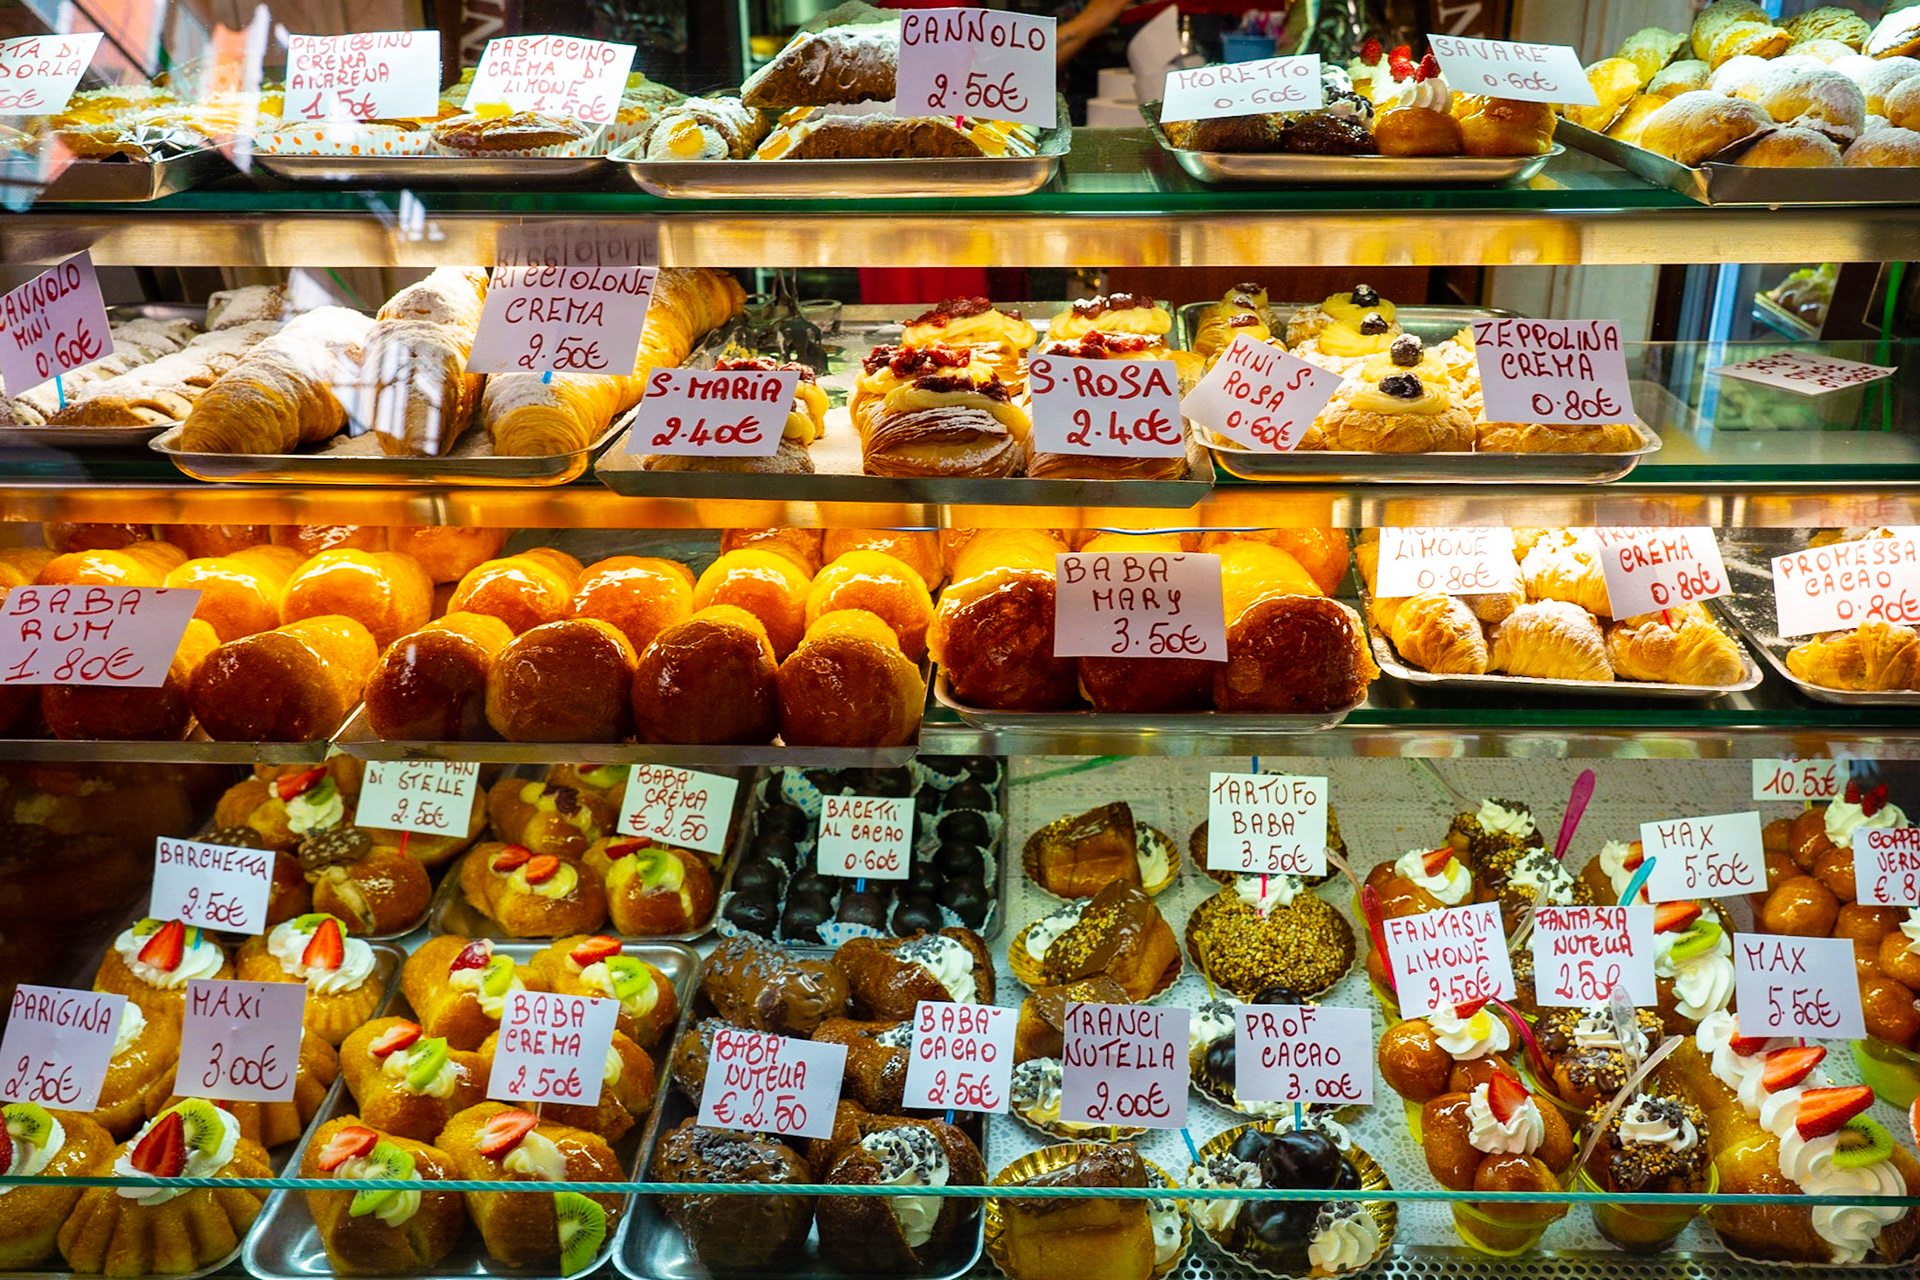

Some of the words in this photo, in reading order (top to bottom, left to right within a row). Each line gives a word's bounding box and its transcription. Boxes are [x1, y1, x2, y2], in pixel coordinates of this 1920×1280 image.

[289, 31, 413, 55] PASTICCINO
[902, 10, 1045, 51] CANNOLO
[297, 51, 367, 71] CREMA
[490, 36, 616, 64] PASTICCINO
[292, 62, 389, 90] AMARENA
[488, 58, 555, 77] CREMA
[1179, 59, 1309, 89] MORETTO
[1483, 71, 1558, 92] 0.60€
[503, 79, 586, 98] LIMONE
[927, 72, 1029, 113] 2.50€
[1214, 85, 1307, 109] 0.60€
[531, 95, 611, 122] 1.50€
[492, 265, 654, 296] RICCIOLONE
[505, 297, 604, 327] CREMA
[36, 317, 103, 379] 0.60€
[518, 333, 609, 370] 2.50€
[1475, 319, 1619, 352] ZEPPOLINA
[1073, 364, 1173, 400] ROSA
[1501, 351, 1595, 382] CREMA
[1223, 370, 1285, 413] ROSA
[1532, 387, 1623, 421] 0.80€
[651, 415, 764, 447] 2.40€
[1067, 408, 1183, 448] 2.40€
[1226, 410, 1294, 452] 0.60€
[1395, 537, 1488, 561] LIMONE
[1619, 534, 1694, 573] CREMA
[1779, 539, 1917, 580] PROMESSA
[1417, 562, 1500, 591] 0.80€
[1651, 562, 1721, 605] 0.80€
[1805, 568, 1892, 597] CACAO
[1092, 587, 1182, 616] MARY
[20, 618, 115, 642] RUM
[1111, 617, 1207, 655] 3.50€
[5, 647, 145, 681] 1.80€
[398, 770, 465, 797] STELLE
[1212, 775, 1317, 806] TARTUFO
[1762, 764, 1841, 798] 10.50€
[391, 797, 450, 829] 2.50€
[645, 788, 708, 812] CREMA
[826, 798, 901, 822] BACETTI
[820, 822, 841, 839] AL
[850, 824, 904, 843] CACAO
[1657, 821, 1714, 851] MAX
[1868, 828, 1920, 851] COPPA
[160, 842, 268, 881] BARCHETTA
[844, 848, 900, 872] 0.60€
[1241, 840, 1313, 874] 3.50€
[1685, 852, 1755, 889] 5.50€
[181, 886, 249, 927] 2.50€
[1535, 906, 1628, 931] FANTASIA
[1389, 910, 1497, 945] FANTASIA
[1406, 936, 1490, 975] LIMONE
[1553, 932, 1634, 958] NUTELLA
[1744, 941, 1807, 975] MAX
[1768, 985, 1842, 1028] 5.50€
[505, 1028, 581, 1058] CREMA
[920, 1035, 997, 1063] CACAO
[1064, 1038, 1175, 1070] NUTELLA
[1261, 1042, 1342, 1068] CACAO
[4, 1055, 82, 1105] 2.50€
[202, 1042, 289, 1091] 3.00€
[508, 1064, 583, 1098] 2.50€
[723, 1060, 807, 1092] NUTELLA
[927, 1069, 1000, 1110] 2.50€
[1086, 1081, 1171, 1121] 2.00€
[1286, 1073, 1363, 1101] 3.00€
